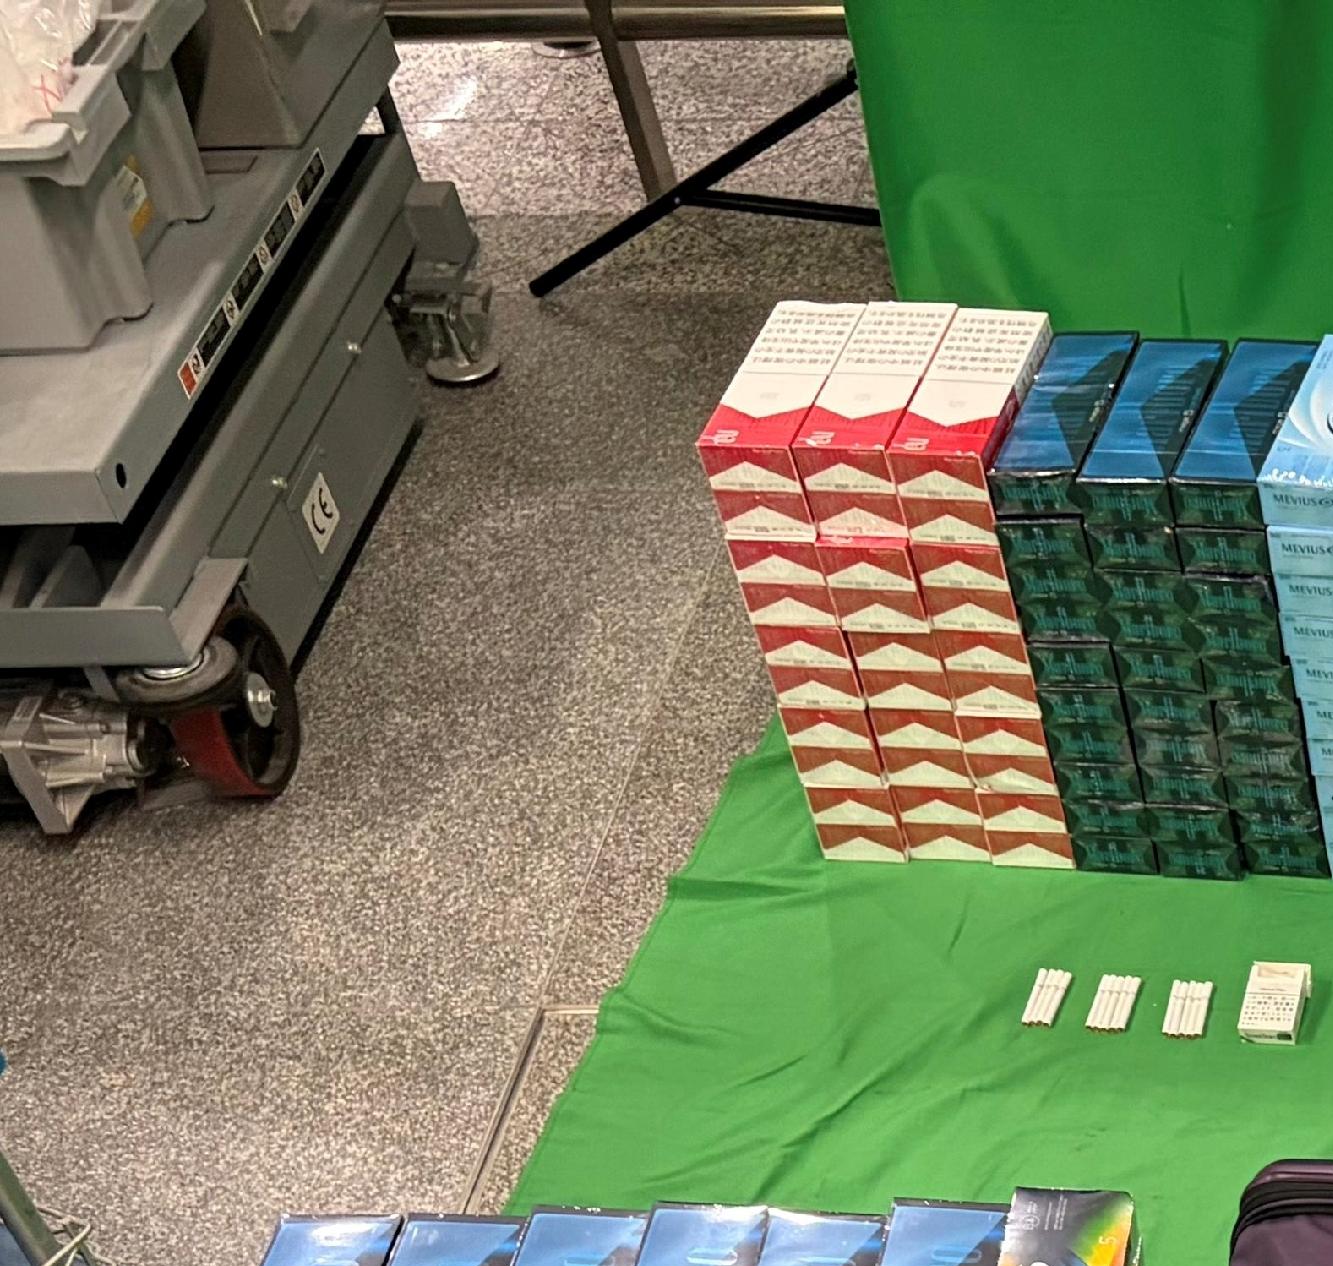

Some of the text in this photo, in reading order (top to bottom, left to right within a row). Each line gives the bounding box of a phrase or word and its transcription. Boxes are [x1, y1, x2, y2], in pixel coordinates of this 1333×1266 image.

[1273, 493, 1318, 507] MEVIUS
[311, 487, 333, 534] CE
[1280, 543, 1327, 556] MEVIUS
